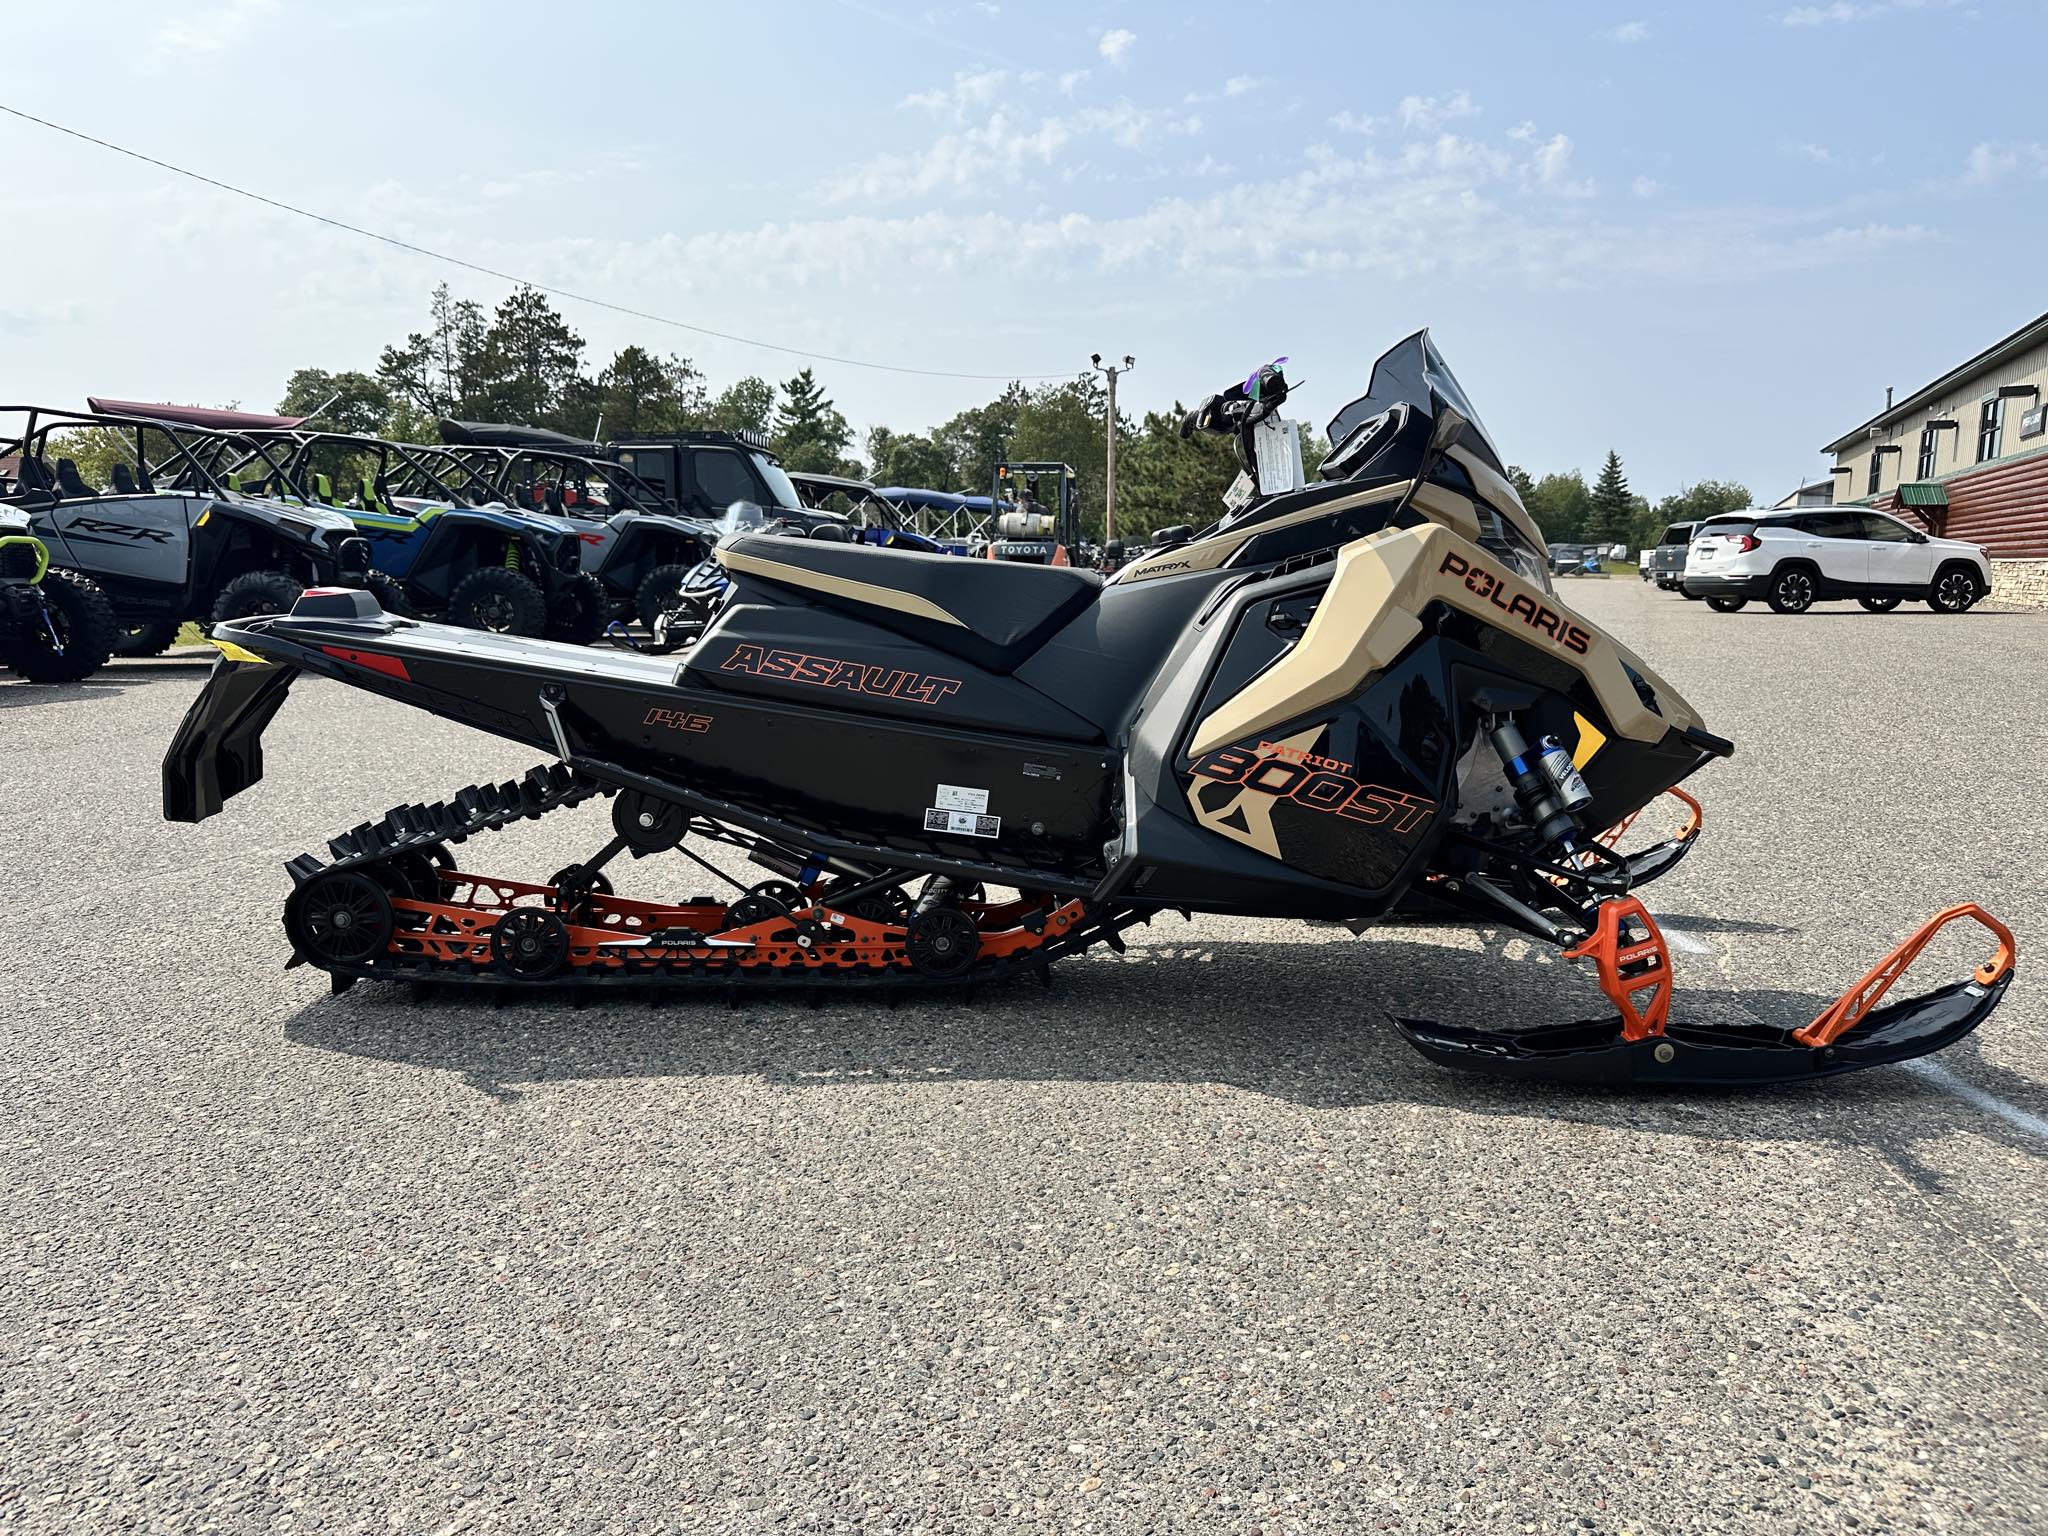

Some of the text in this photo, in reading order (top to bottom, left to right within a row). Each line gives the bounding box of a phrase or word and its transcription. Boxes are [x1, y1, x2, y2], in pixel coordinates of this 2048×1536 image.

[65, 517, 175, 544] RZR
[1001, 546, 1047, 554] TOYOTA
[1133, 560, 1192, 578] MATRYX
[1438, 551, 1591, 655] POLARIS
[720, 643, 962, 705] ASSAULT
[643, 708, 713, 733] 146
[1257, 740, 1353, 774] PATRIOT
[1187, 746, 1435, 833] BOOST
[1619, 945, 1658, 962] POLARIS
